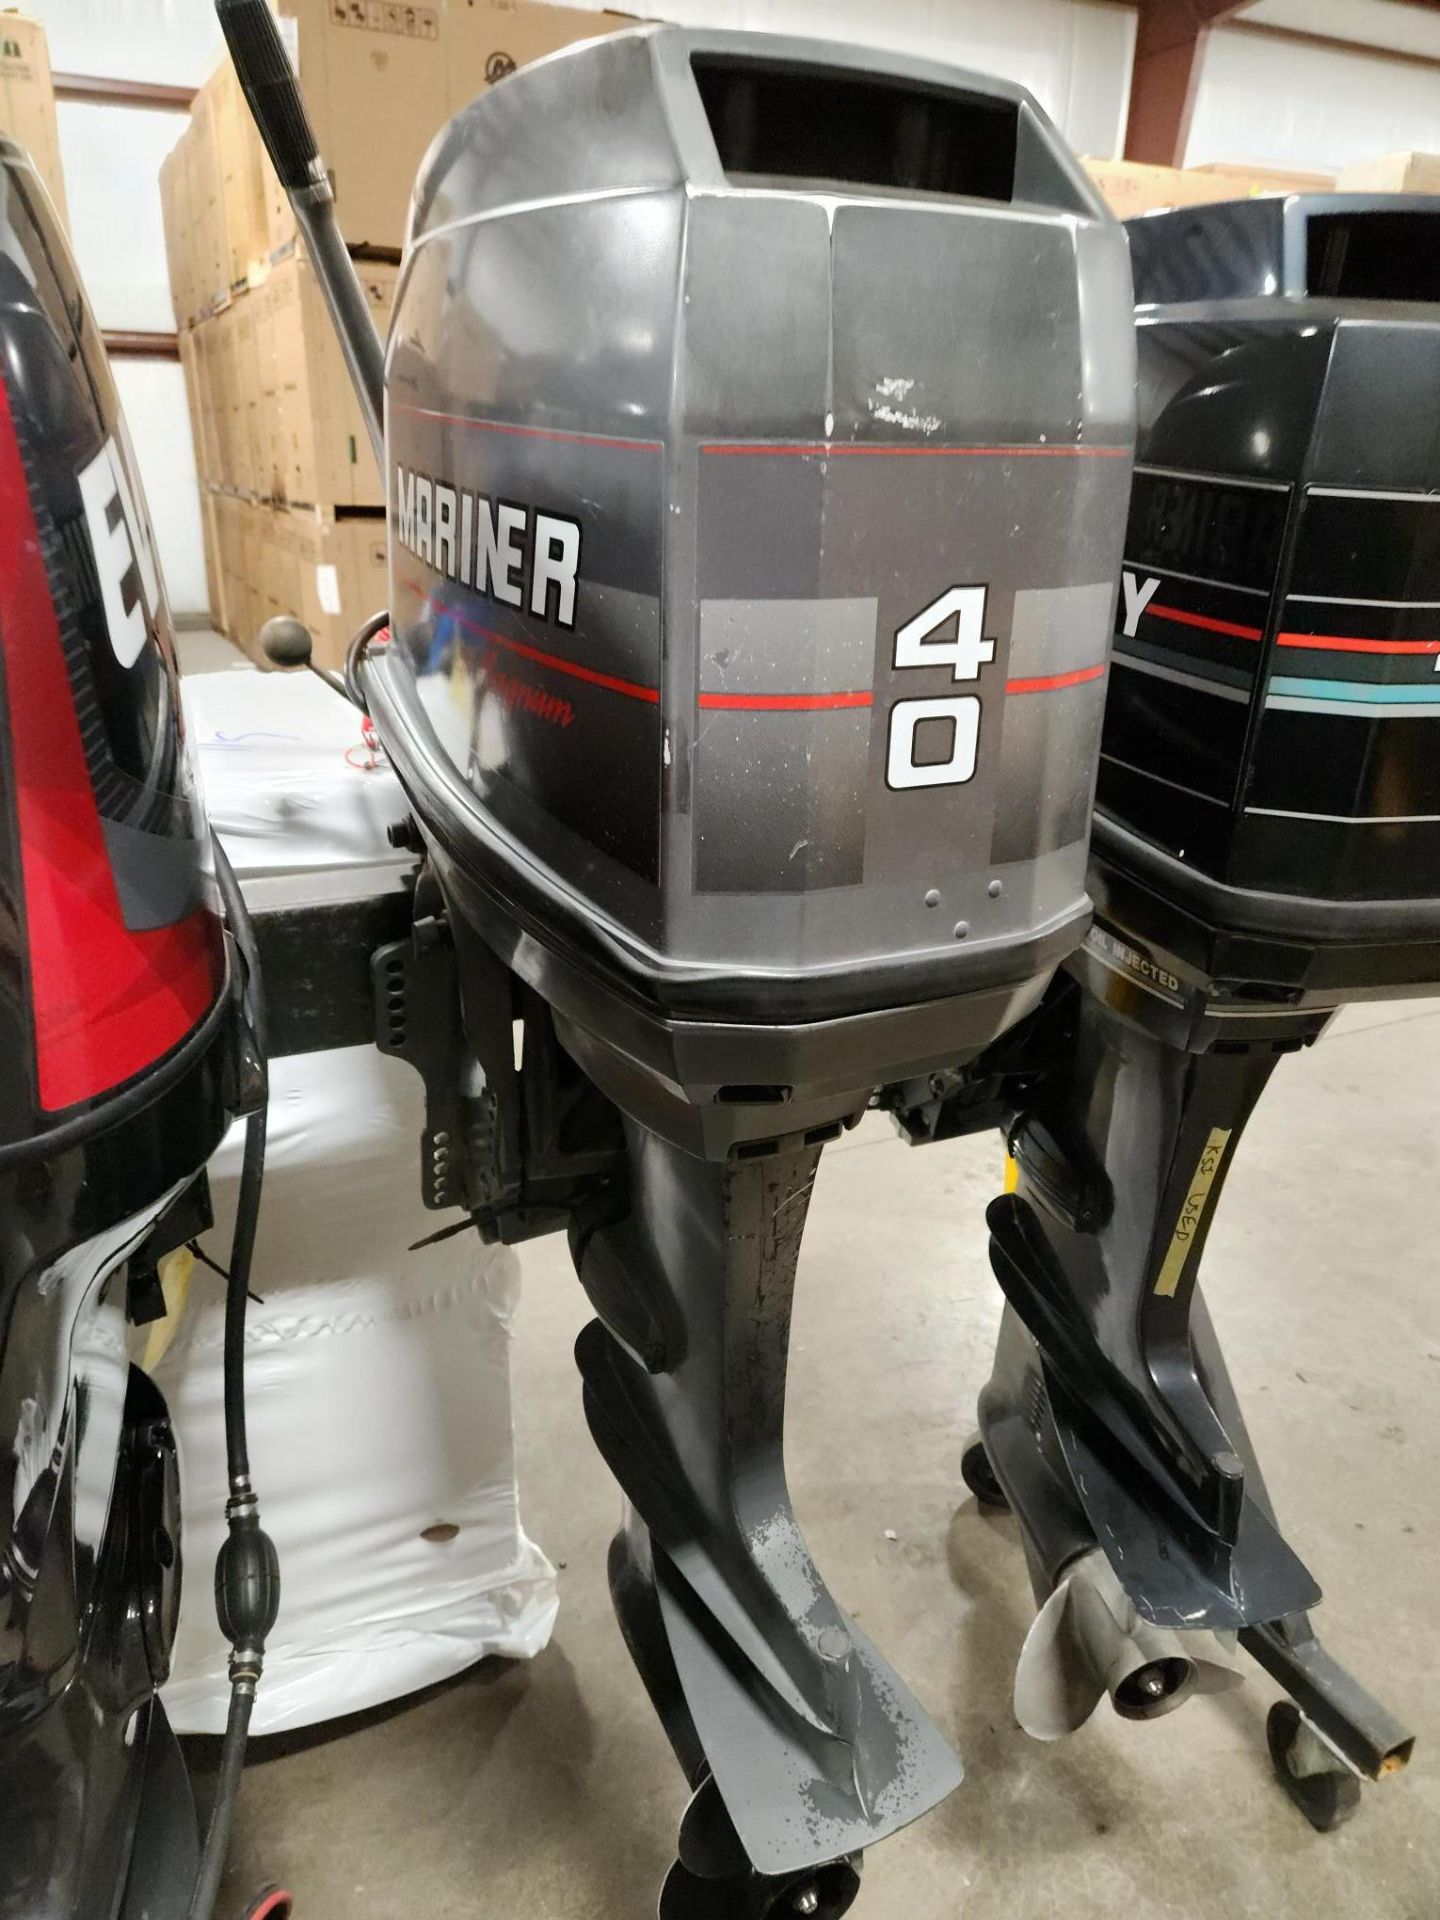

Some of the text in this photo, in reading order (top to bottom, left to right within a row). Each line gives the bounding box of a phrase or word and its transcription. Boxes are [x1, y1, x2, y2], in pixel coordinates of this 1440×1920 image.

[397, 464, 582, 631] MARINER
[885, 583, 997, 791] 40
[1091, 926, 1179, 991] OIL INJECTED
[1175, 1192, 1206, 1241] USED
